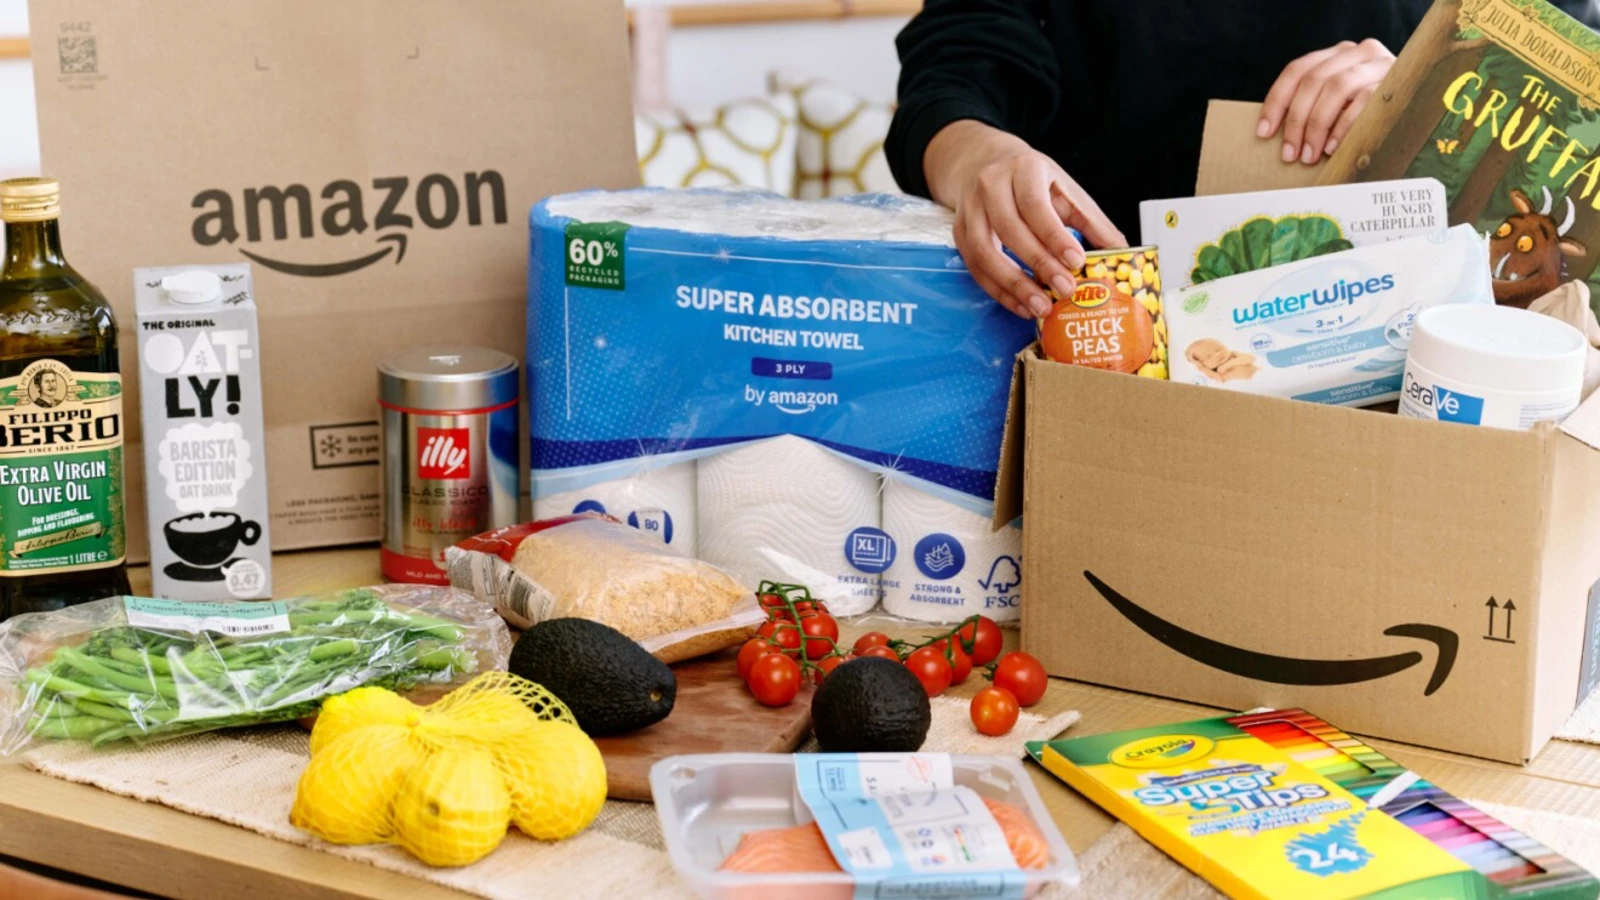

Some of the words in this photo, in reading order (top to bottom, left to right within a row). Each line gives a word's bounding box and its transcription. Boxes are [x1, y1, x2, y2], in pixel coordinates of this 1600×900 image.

[1481, 5, 1518, 41] JULIA
[1521, 28, 1598, 88] DONALDSON
[1520, 74, 1562, 115] THE
[1443, 71, 1600, 211] GRUFFA
[1371, 192, 1397, 205] THE
[1400, 189, 1433, 202] VERY
[191, 170, 508, 246] amazon
[1382, 202, 1433, 217] HUNGRY
[1350, 215, 1435, 233] CATERPILLAR
[569, 237, 619, 267] 60%
[569, 265, 619, 276] RECYCLED
[569, 273, 620, 285] PACKAGING
[676, 285, 755, 316] SUPER
[759, 295, 918, 325] ABSORBENT
[1057, 313, 1080, 321] COOKED
[1087, 310, 1107, 318] READY
[1118, 306, 1130, 314] USE
[142, 321, 165, 330] THE
[167, 319, 216, 330] ORIGINAL
[1064, 317, 1125, 339] CHICK
[724, 323, 797, 347] KITCHEN
[800, 330, 864, 351] TOWEL
[1071, 335, 1121, 357] PEAS
[1344, 340, 1367, 353] baby
[144, 330, 253, 375] OAT-
[1080, 356, 1101, 364] SALTED
[1103, 354, 1123, 362] WATER
[775, 364, 783, 374] 3
[786, 364, 806, 375] PLY
[165, 374, 241, 419] LY!
[744, 384, 765, 406] by
[768, 391, 838, 406] amazon
[1405, 371, 1460, 415] CeraVe
[8, 409, 92, 425] FILIPPO
[169, 439, 238, 462] BARISTA
[421, 435, 467, 476] illy
[0, 465, 50, 485] EXTRA
[53, 460, 107, 481] VIRGIN
[174, 460, 237, 482] EDITION
[17, 485, 63, 506] OLIVE
[65, 481, 92, 502] OIL
[179, 484, 200, 499] OAT
[201, 483, 233, 498] DRINK
[403, 486, 489, 498] CLASSICO
[17, 525, 42, 538] DIPPING
[43, 521, 56, 532] AND
[57, 512, 95, 529] FLAVOURING
[32, 515, 45, 525] FOR
[644, 519, 659, 531] 80
[857, 538, 875, 551] XL
[69, 554, 73, 563] 1
[76, 552, 97, 563] LITRE
[230, 572, 259, 588] 0.47
[838, 575, 868, 585] EXTRA
[870, 577, 901, 589] LARGE
[914, 583, 953, 594] STRONG
[954, 586, 961, 594] &
[851, 587, 888, 598] SHEETS
[909, 594, 966, 607] ABSORBENT
[985, 595, 1020, 609] FSC
[1125, 738, 1189, 760] Crayola
[1134, 771, 1279, 806] Super
[1224, 784, 1329, 811] Tips
[1292, 842, 1359, 869] 24
